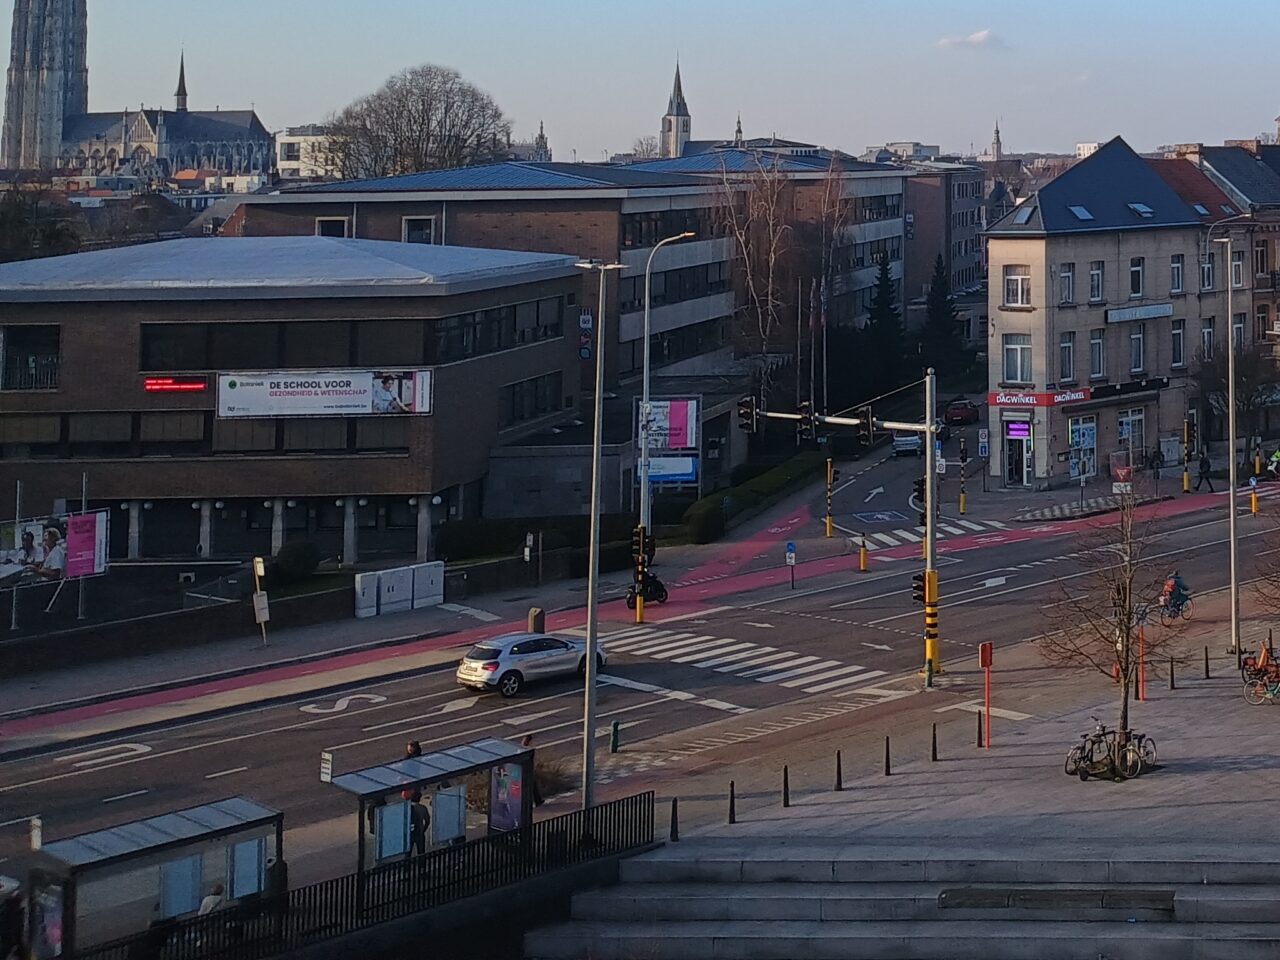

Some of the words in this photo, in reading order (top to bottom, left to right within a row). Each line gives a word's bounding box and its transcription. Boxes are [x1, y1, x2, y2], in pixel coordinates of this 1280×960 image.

[269, 381, 282, 390] DE
[283, 380, 322, 389] SCHOOL
[324, 380, 352, 389] VOOR
[996, 395, 1038, 404] DAGWINKEL
[1054, 391, 1085, 402] DAGWINKEL
